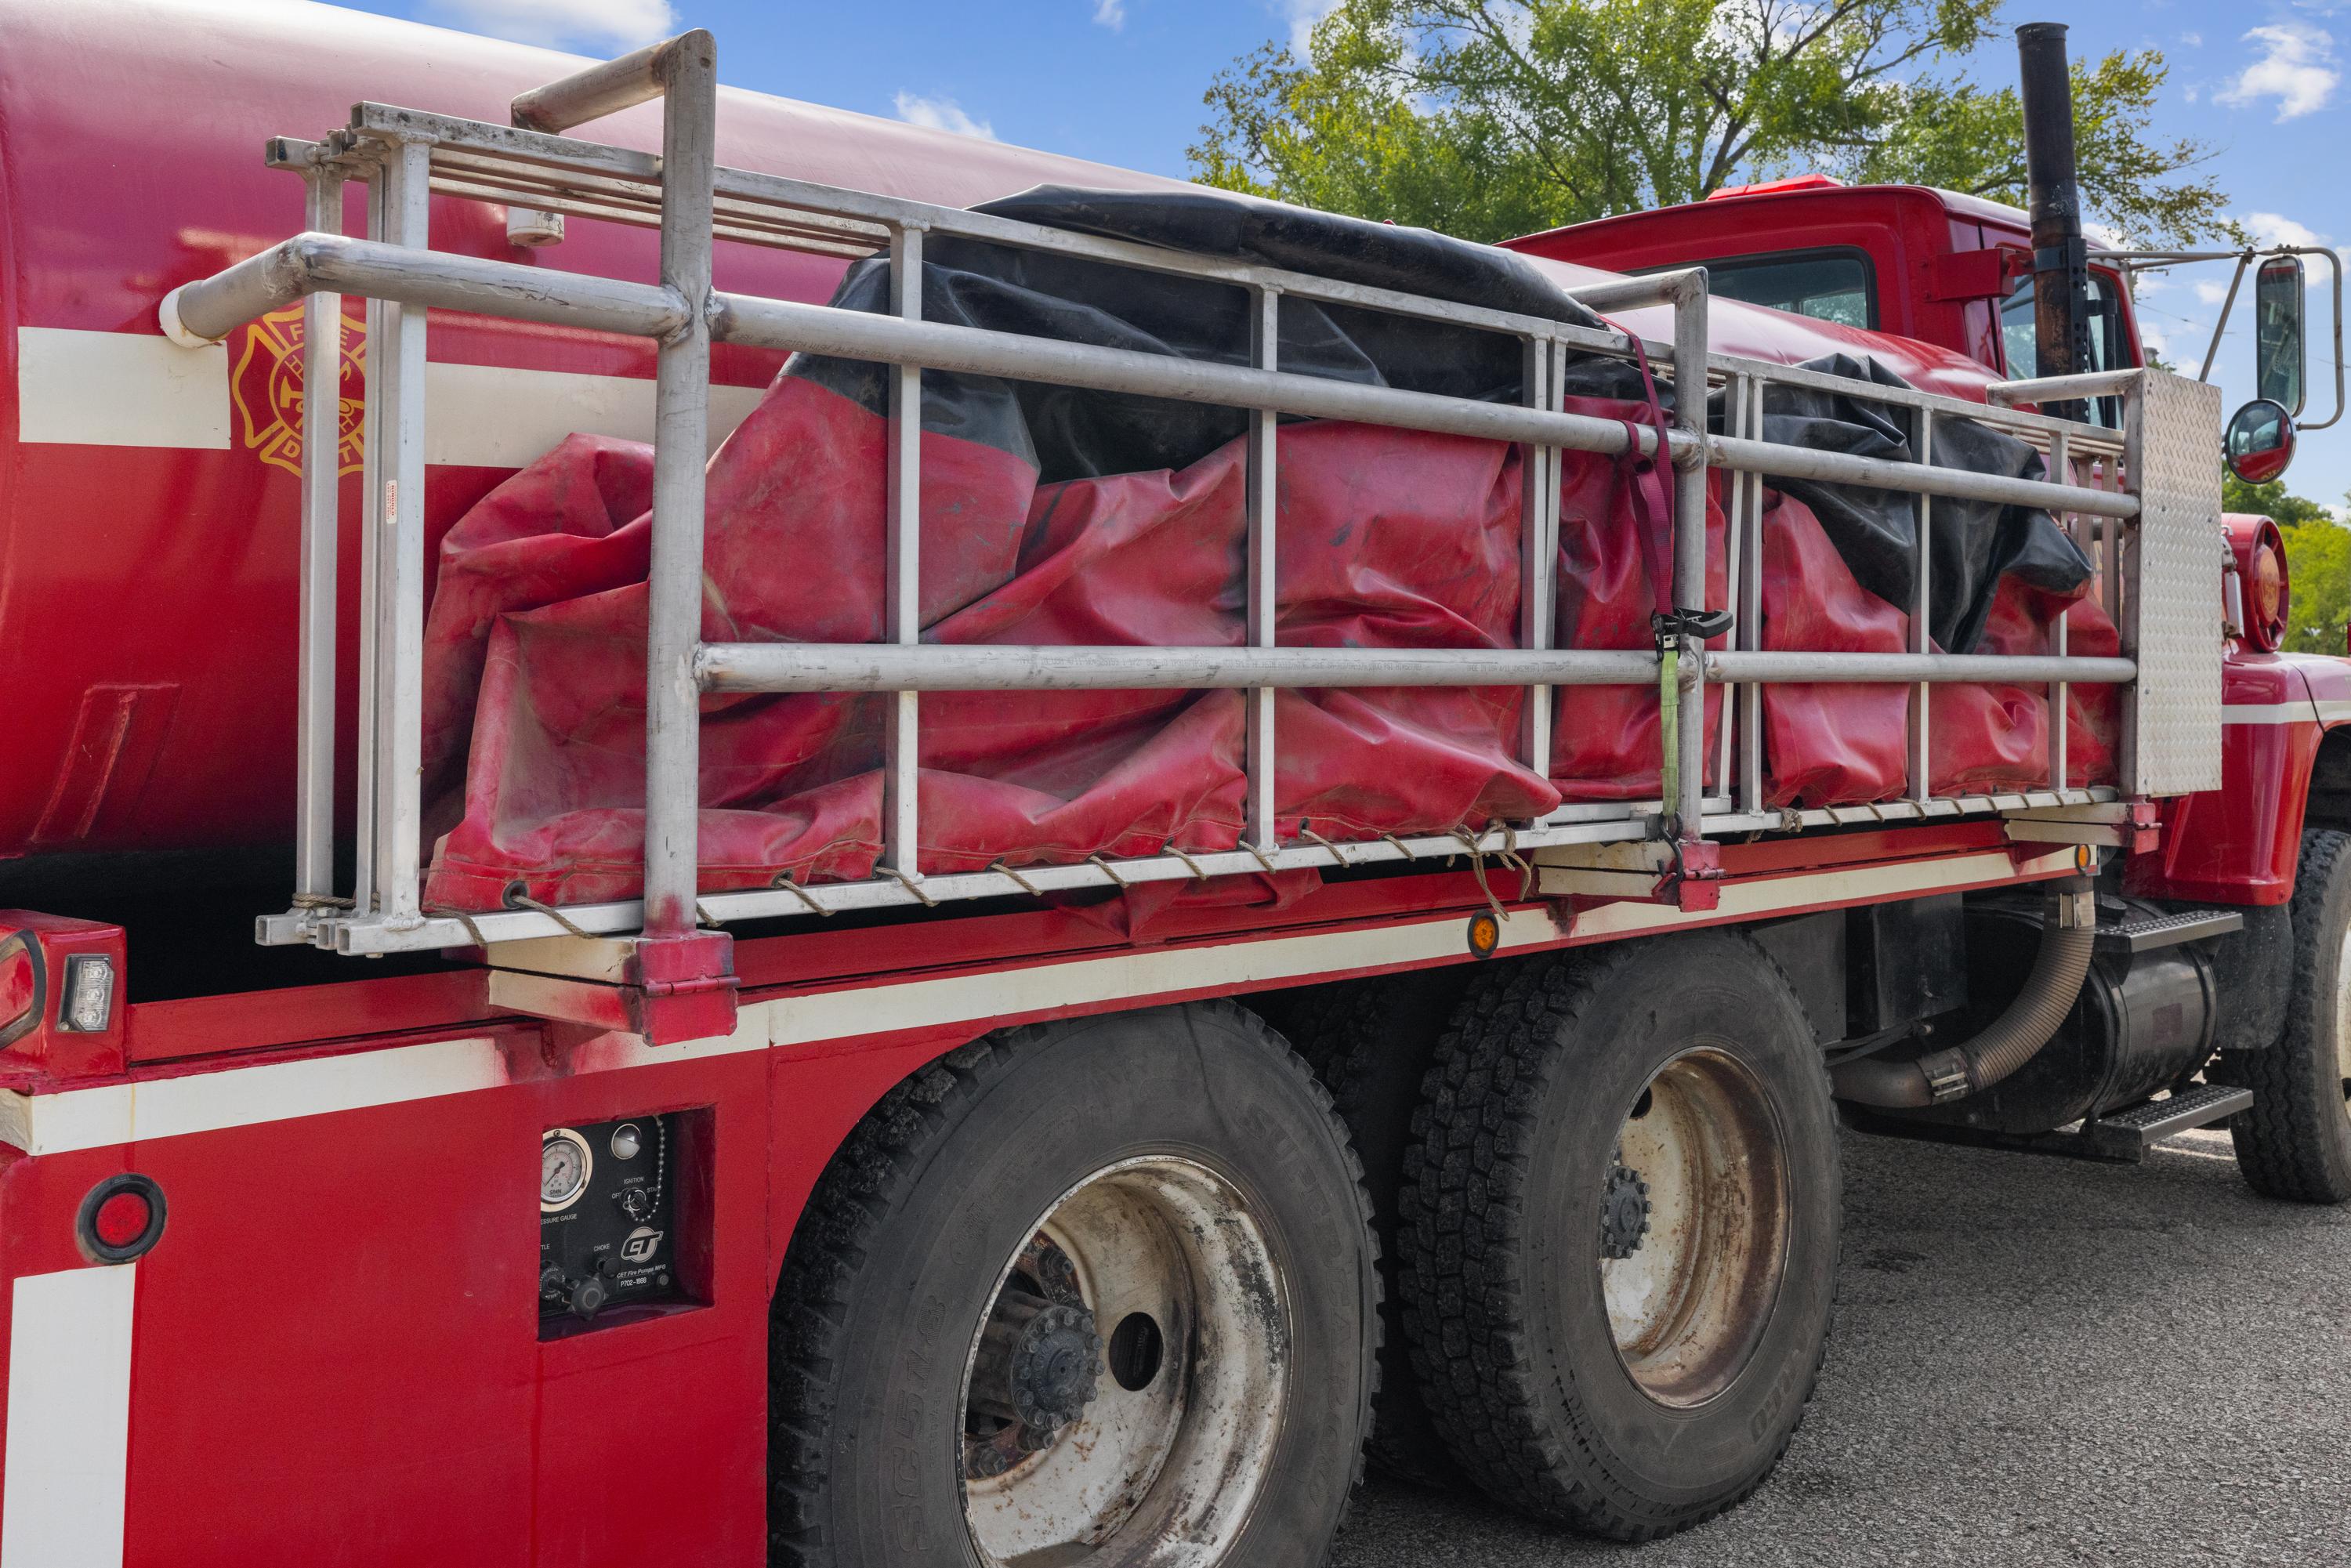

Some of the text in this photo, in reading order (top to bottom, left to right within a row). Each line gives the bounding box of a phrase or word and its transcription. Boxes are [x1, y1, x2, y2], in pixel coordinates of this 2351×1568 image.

[289, 323, 350, 346] FE
[282, 439, 352, 463] DT
[623, 1176, 644, 1185] IGNITION
[560, 1213, 578, 1222] GAUGE
[593, 1243, 610, 1252] CHOKE
